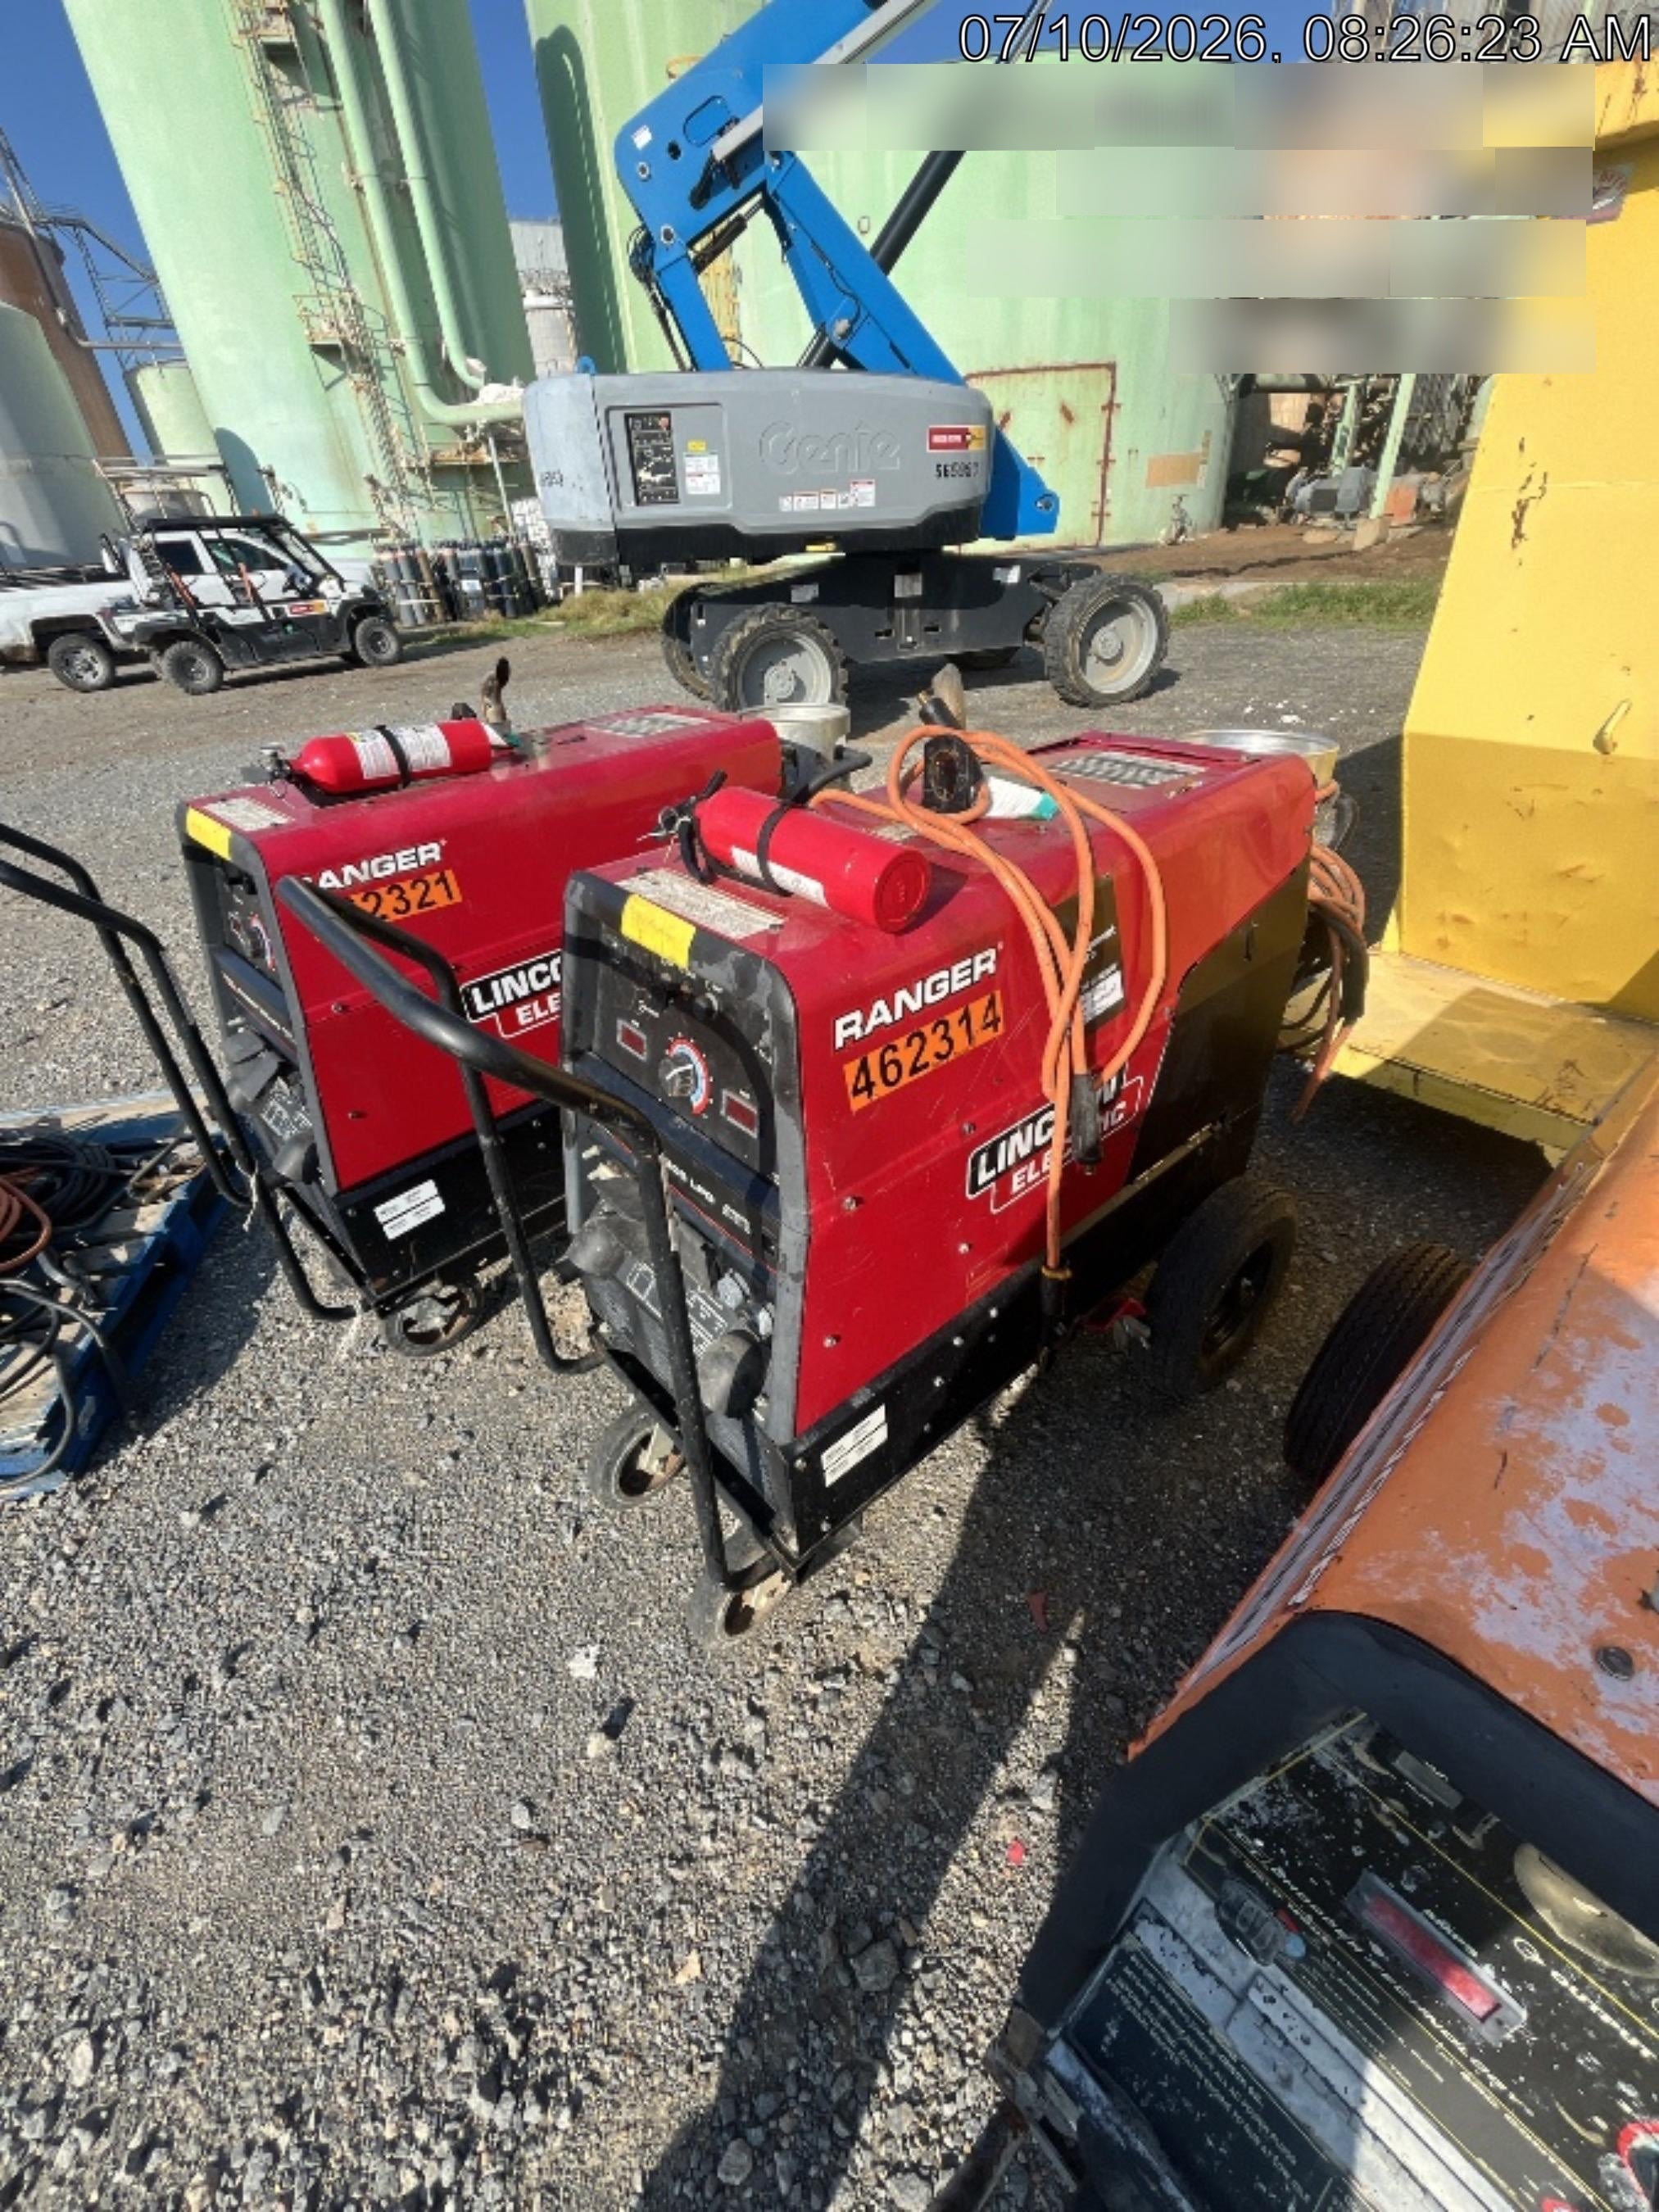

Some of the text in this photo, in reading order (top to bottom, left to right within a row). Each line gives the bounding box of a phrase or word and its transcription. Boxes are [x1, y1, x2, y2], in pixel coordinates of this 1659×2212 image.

[759, 420, 900, 474] Genie
[303, 841, 444, 888] ANGER
[834, 947, 997, 1050] RANGER
[851, 991, 1001, 1099] 462314
